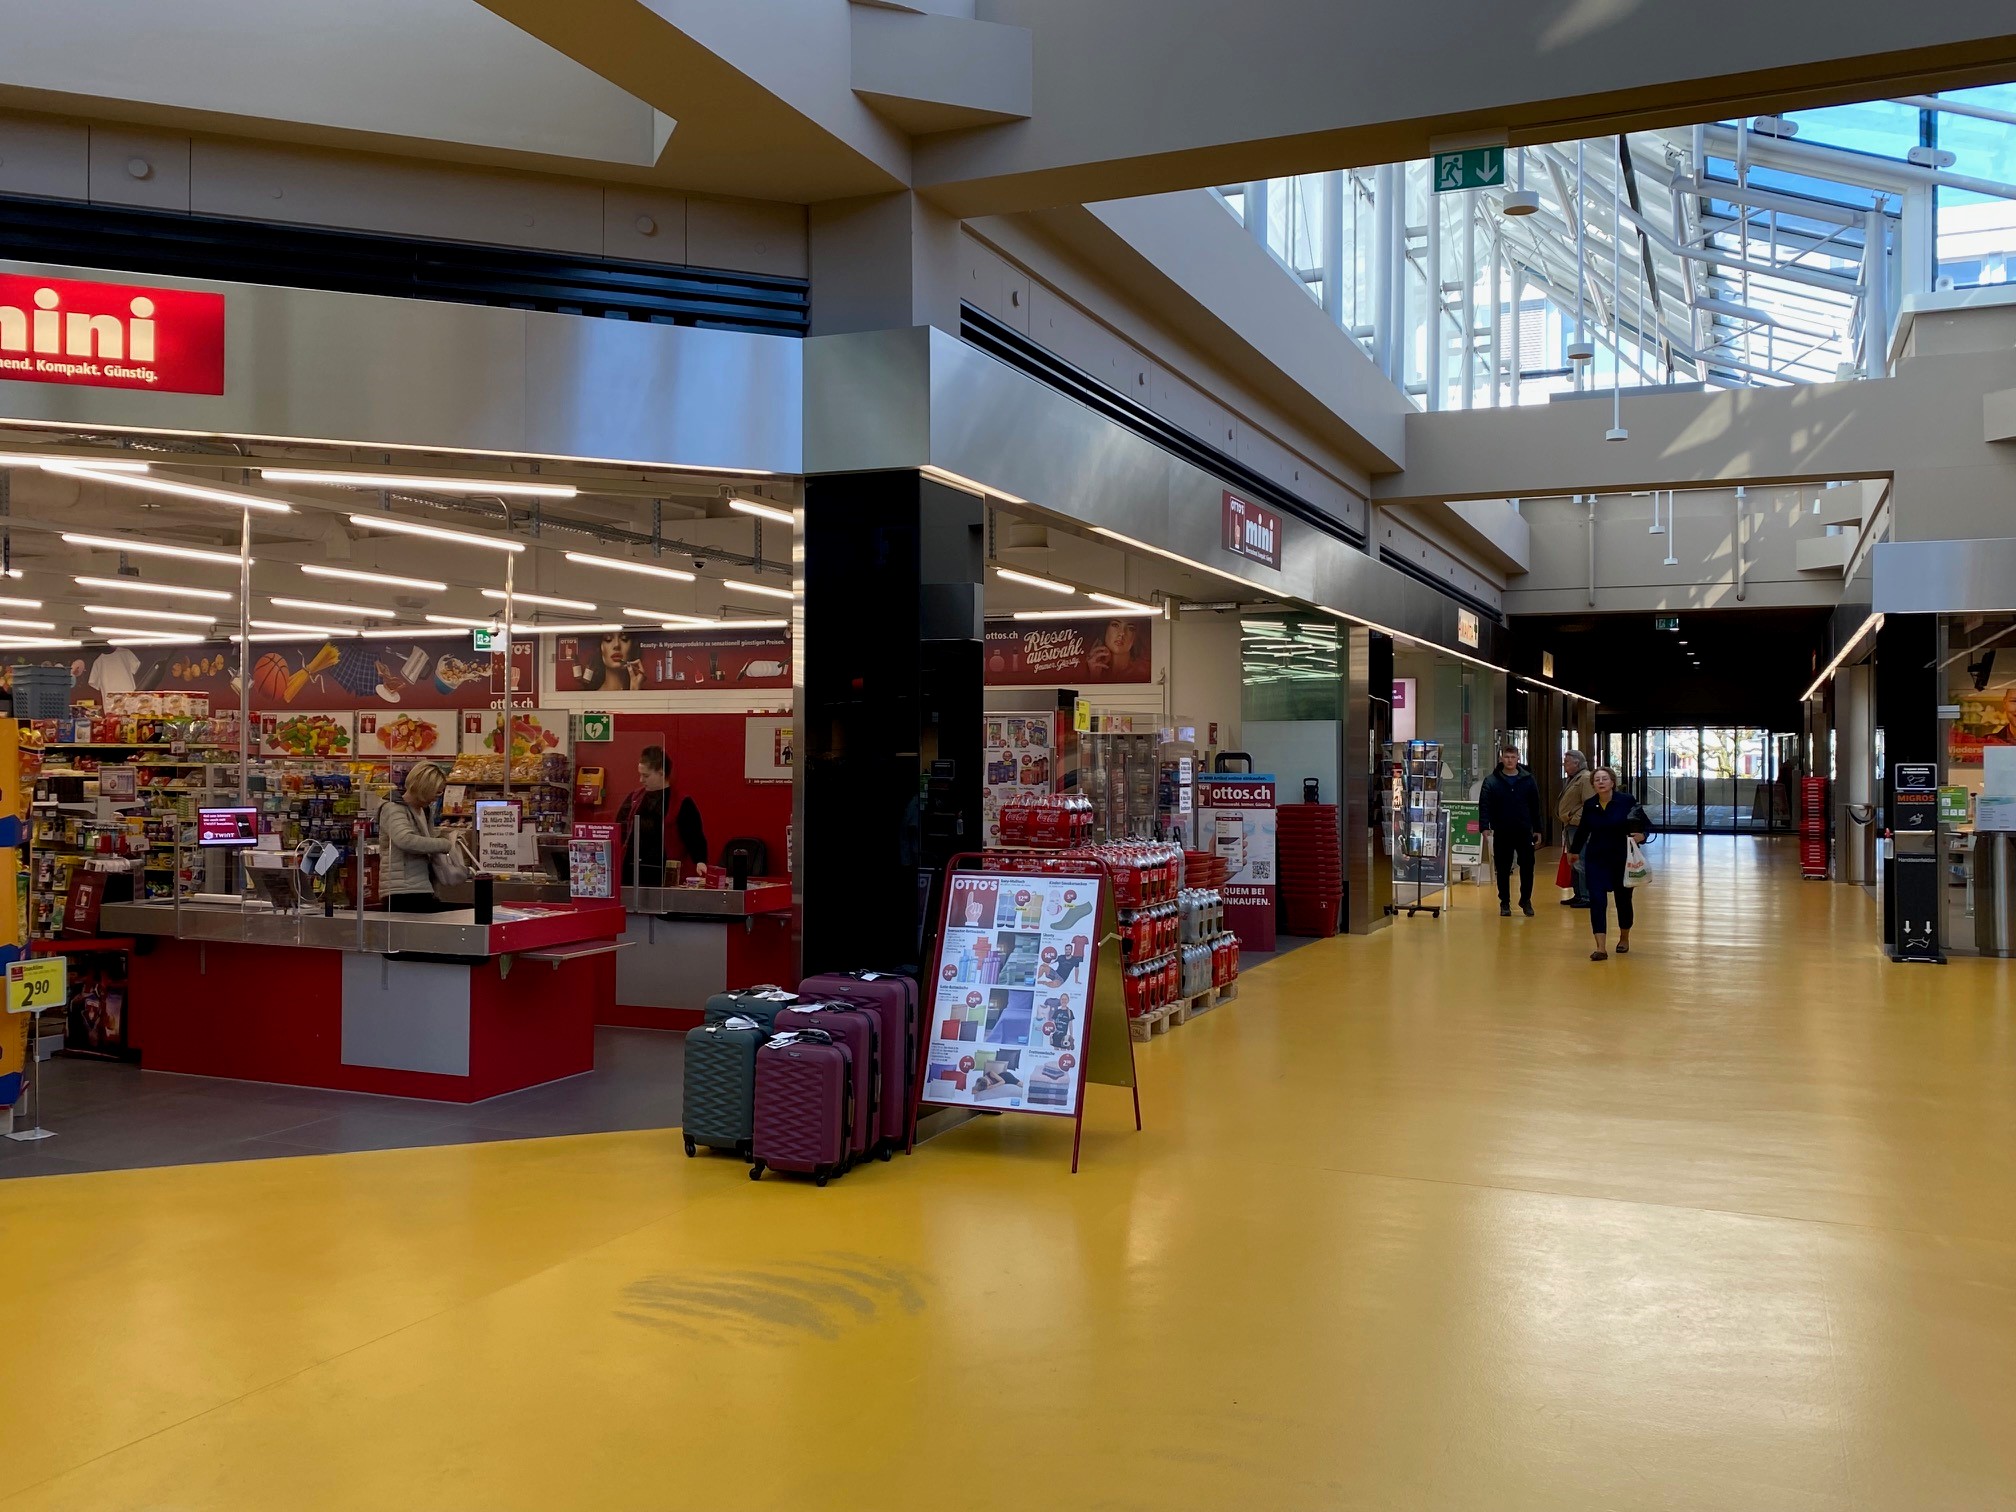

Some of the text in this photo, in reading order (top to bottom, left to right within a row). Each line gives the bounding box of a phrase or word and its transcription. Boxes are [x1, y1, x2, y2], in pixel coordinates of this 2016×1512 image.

[36, 359, 101, 376] Kompakt.
[104, 364, 158, 382] Günstig.
[1245, 513, 1273, 554] mini
[985, 631, 1018, 640] ottos.ch
[1024, 628, 1077, 653] Riesen-
[664, 641, 704, 649] Hygieneprodukte
[741, 640, 765, 648] günstigen
[1027, 637, 1085, 665] auswahl.
[490, 697, 534, 709] otts.ch
[1212, 785, 1271, 800] ottos.ch
[1897, 794, 1935, 802] MIGROS
[955, 880, 998, 891] OTTO'S
[1251, 887, 1265, 895] BEI
